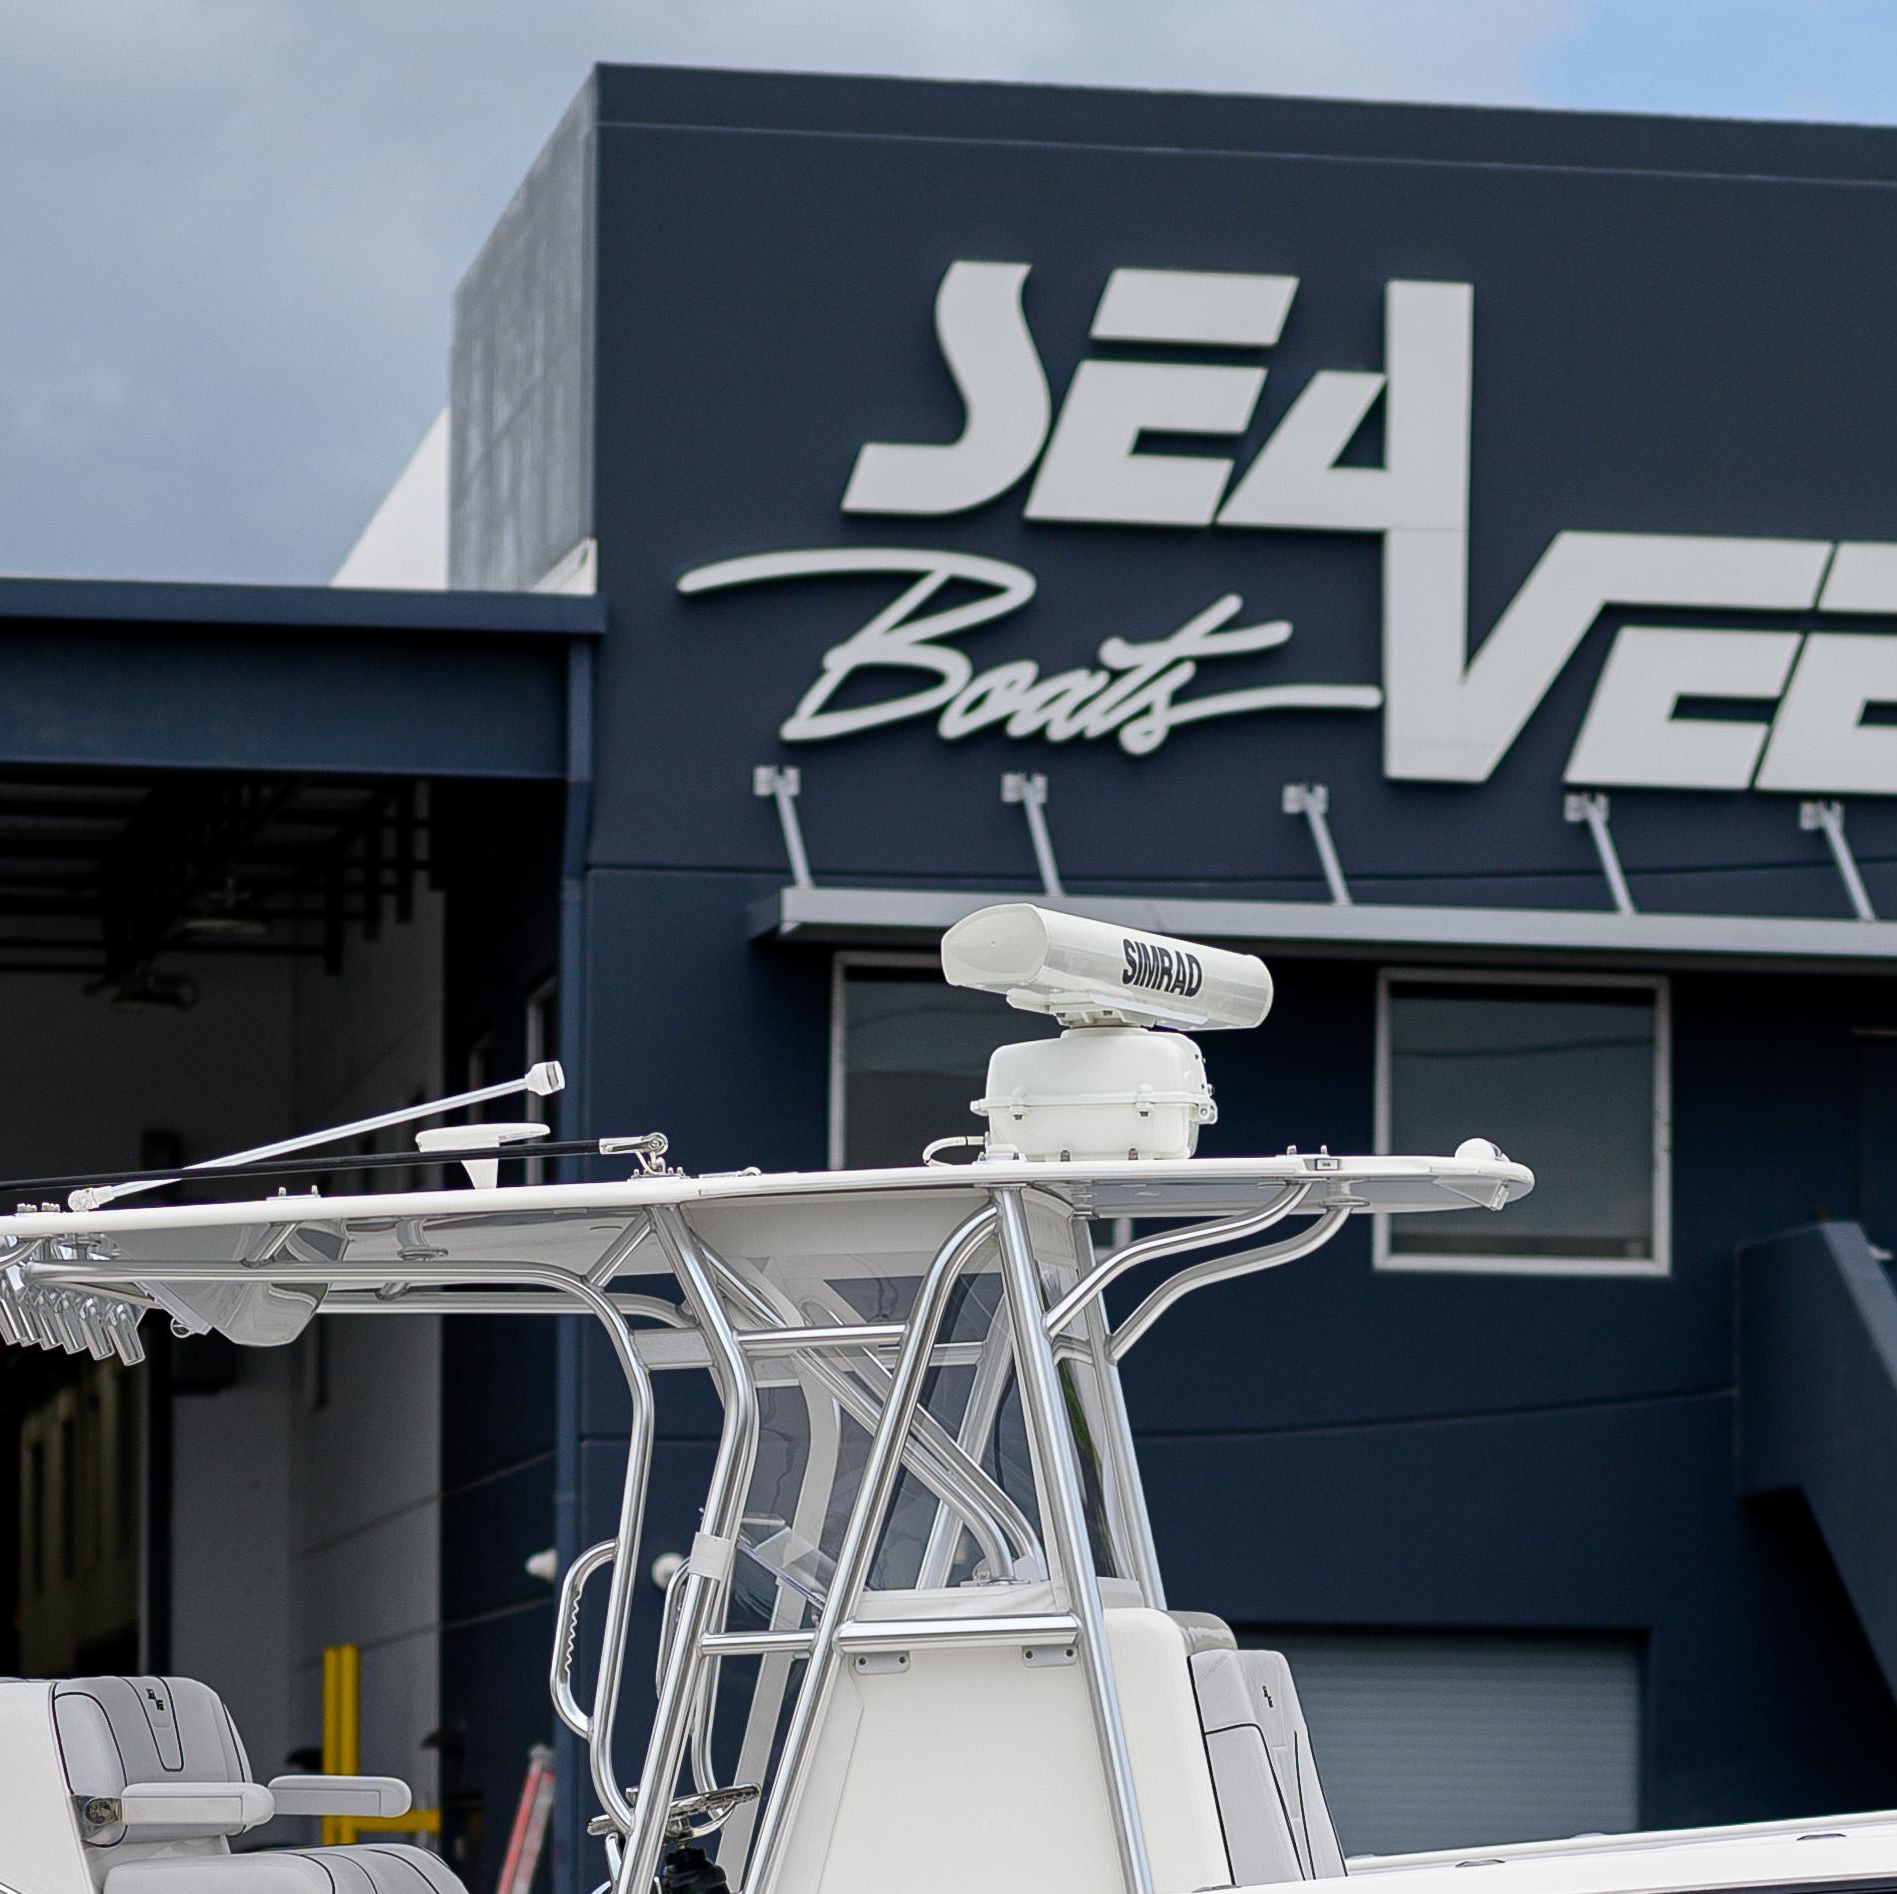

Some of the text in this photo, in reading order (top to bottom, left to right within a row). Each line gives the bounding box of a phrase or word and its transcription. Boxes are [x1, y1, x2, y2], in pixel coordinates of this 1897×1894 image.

[841, 261, 1472, 529] SEA
[677, 546, 1382, 754] Boats
[1122, 938, 1203, 997] SIMRAD
